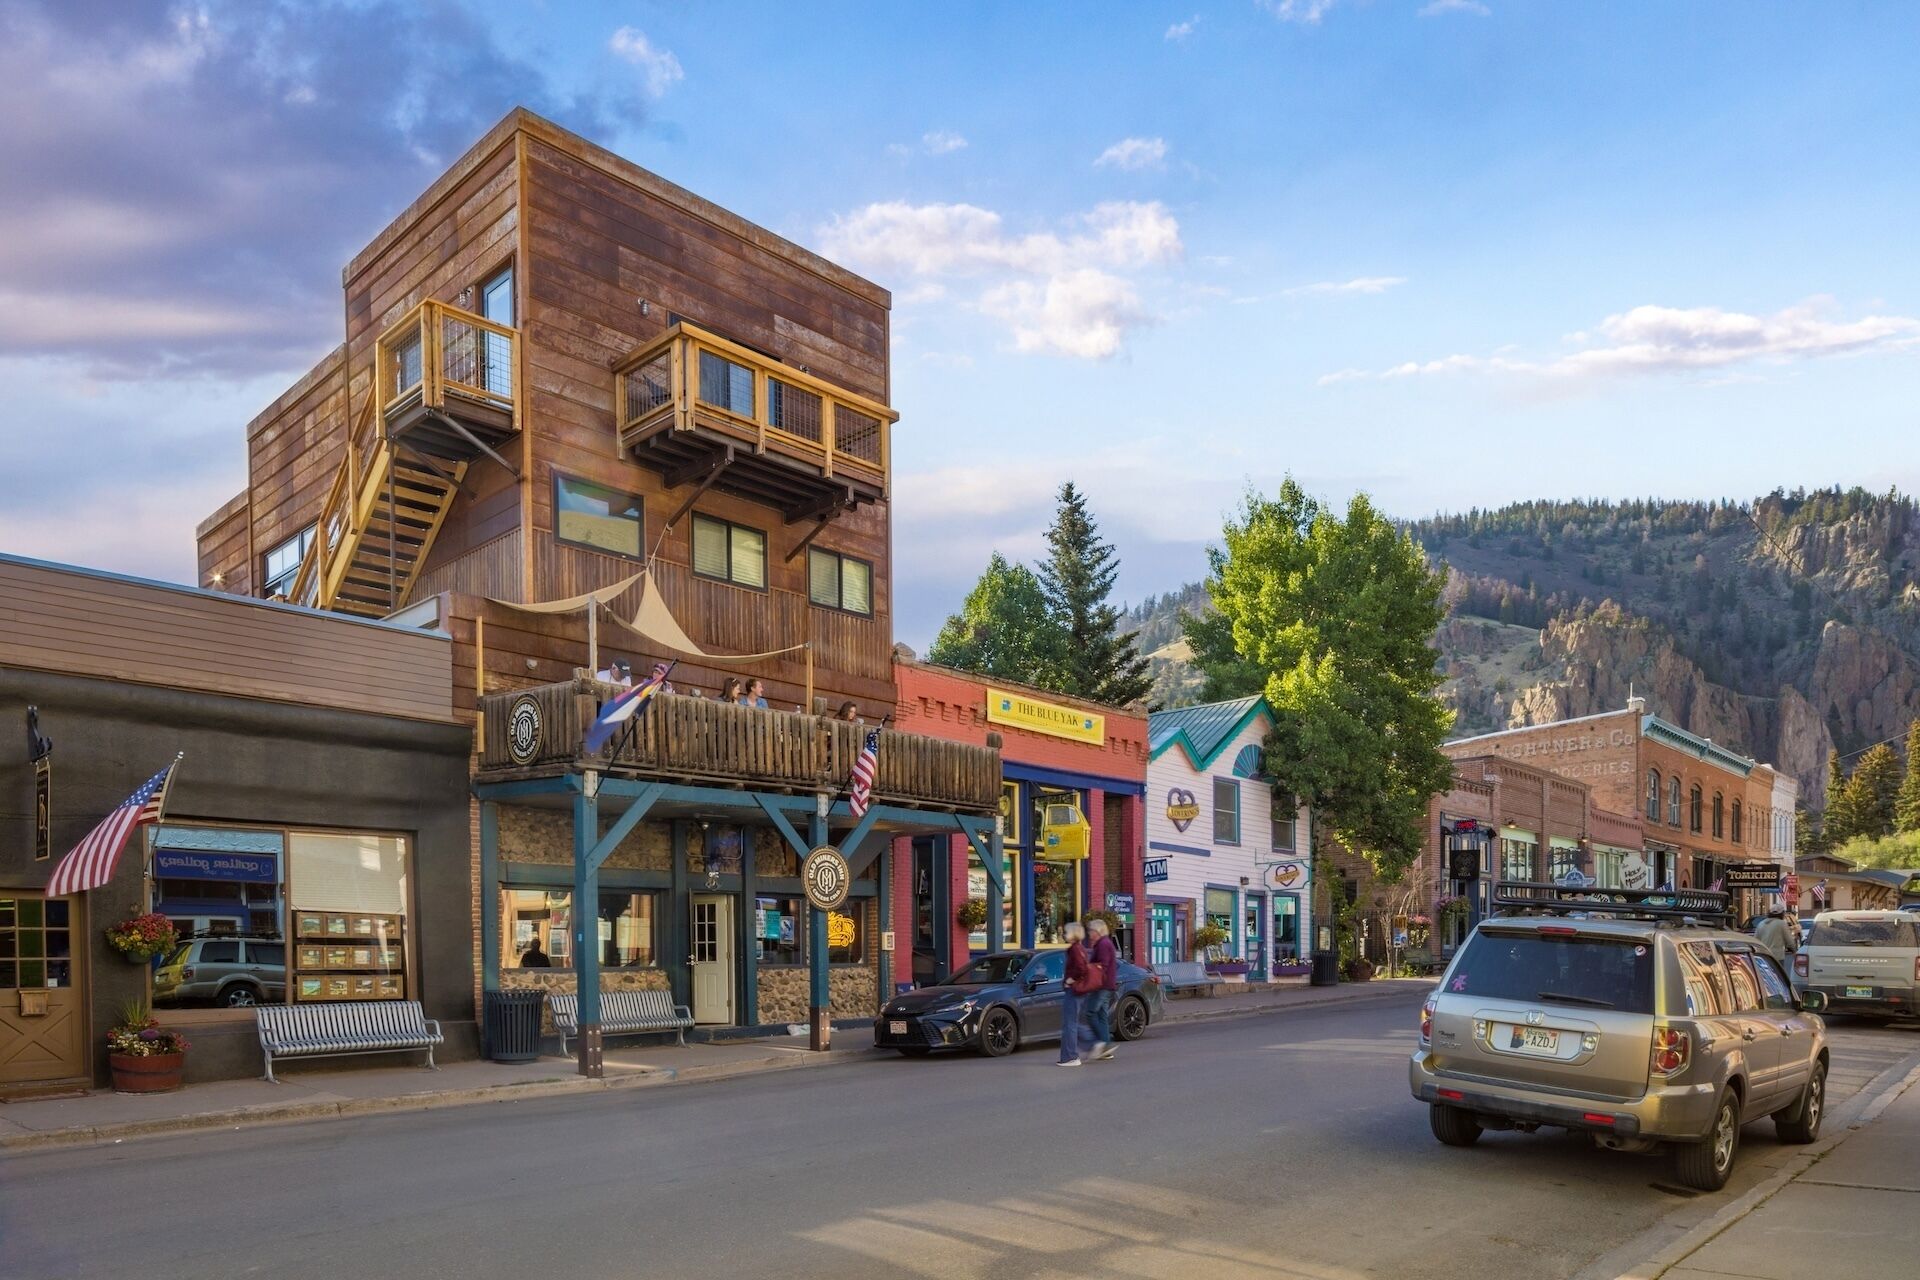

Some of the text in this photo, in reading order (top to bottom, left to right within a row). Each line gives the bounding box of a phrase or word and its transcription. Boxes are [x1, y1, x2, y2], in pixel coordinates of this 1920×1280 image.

[1017, 702, 1079, 726] THE BLUE YAK
[1596, 738, 1607, 749] &
[808, 854, 845, 880] OLD MINERS INN
[1144, 860, 1167, 876] ATM
[1624, 866, 1642, 878] HOLY
[1625, 871, 1647, 888] MOSES
[1729, 871, 1778, 880] TOMKINS
